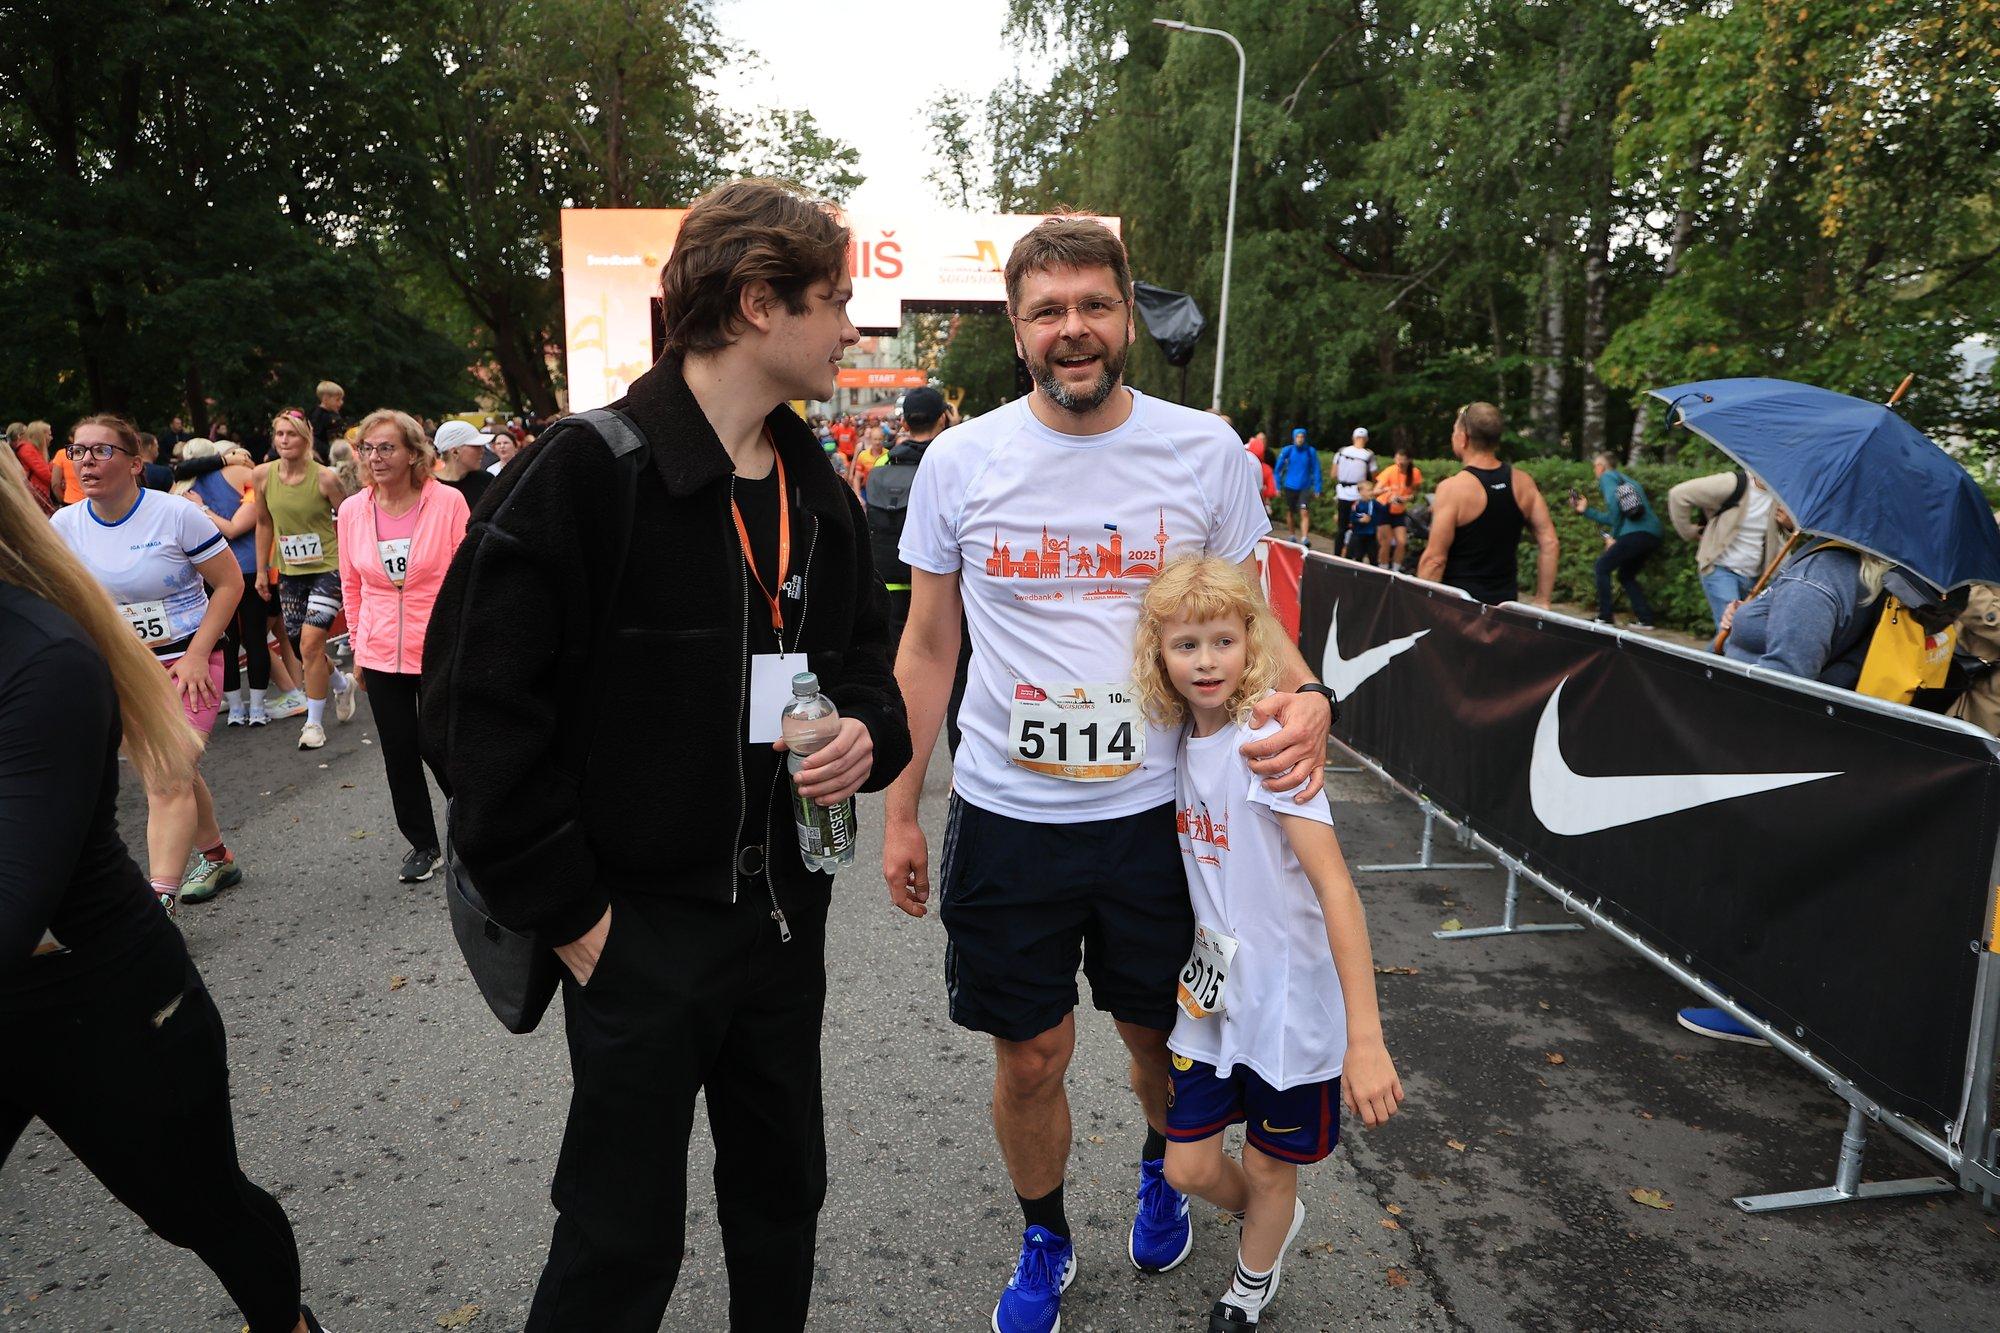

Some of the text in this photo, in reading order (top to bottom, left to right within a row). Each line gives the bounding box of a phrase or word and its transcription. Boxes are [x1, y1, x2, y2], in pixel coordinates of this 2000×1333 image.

[284, 543, 317, 556] 4117
[1128, 550, 1157, 560] 2025
[1109, 692, 1122, 703] 10
[1019, 720, 1136, 762] 5114
